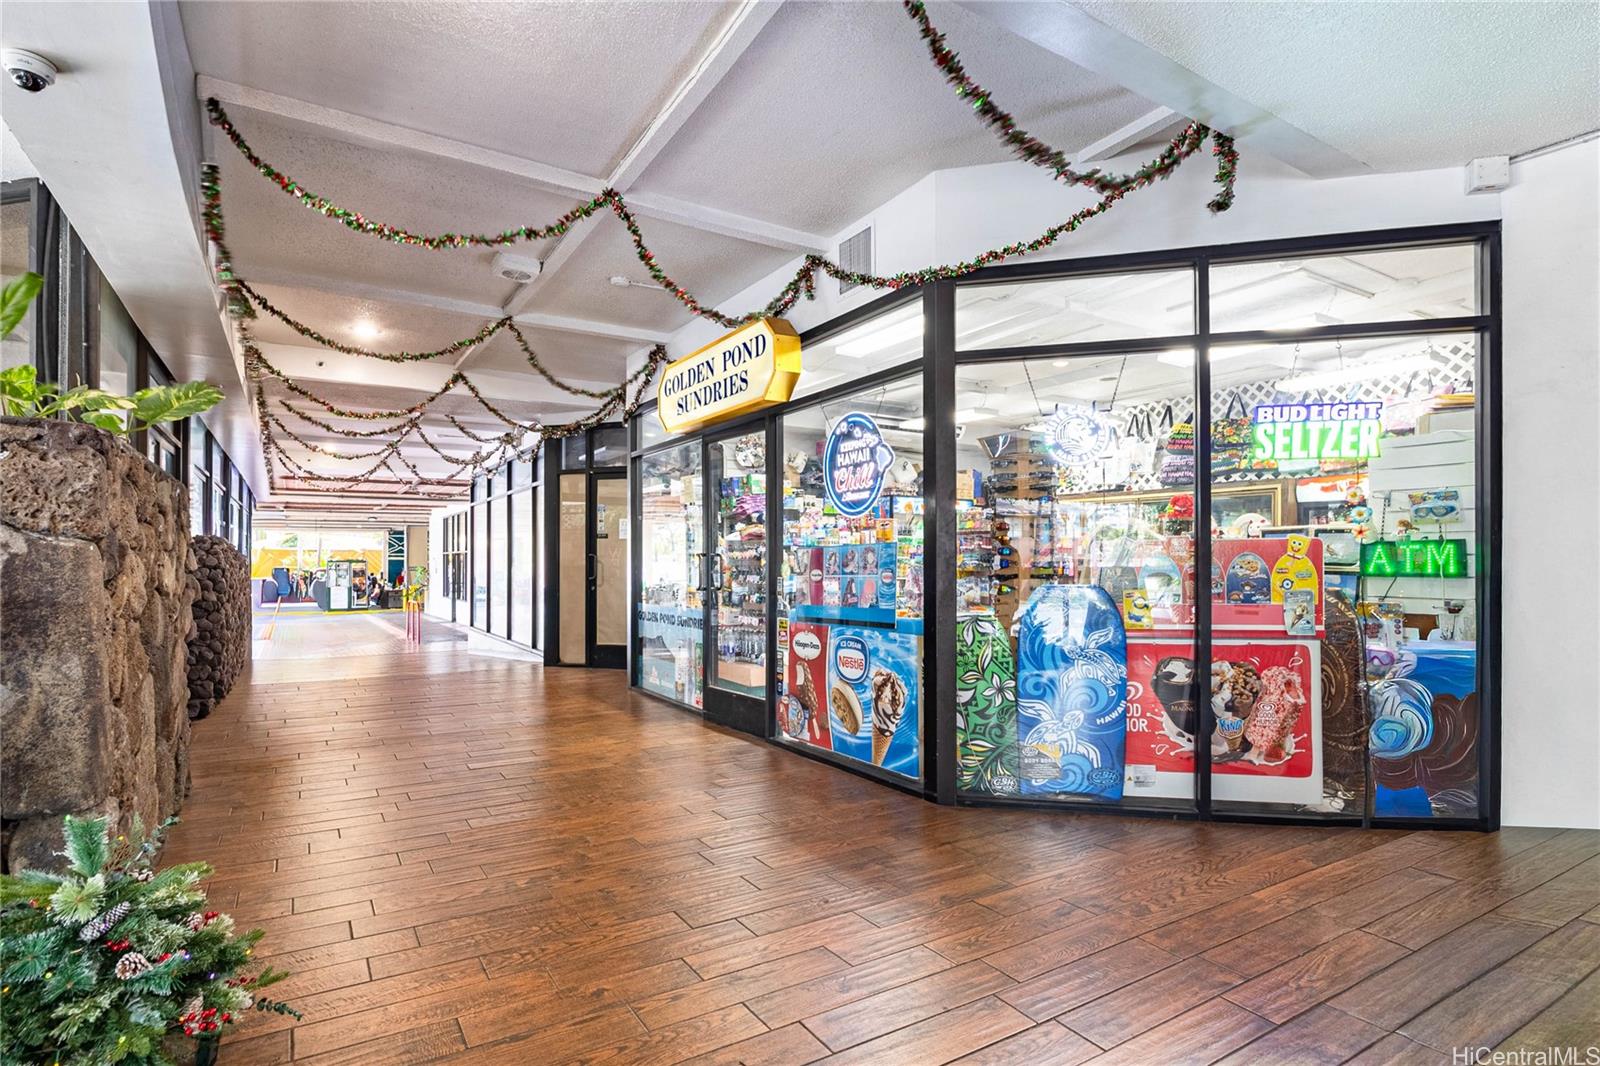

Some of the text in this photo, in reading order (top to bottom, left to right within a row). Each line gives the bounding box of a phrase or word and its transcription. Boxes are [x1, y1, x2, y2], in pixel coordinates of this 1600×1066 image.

[664, 334, 767, 397] GOLDEN POND
[677, 370, 749, 415] SUNDRIES
[1257, 403, 1381, 422] BUD LIGHT
[1255, 420, 1380, 459] SELTZER
[838, 447, 870, 467] HAWAII
[834, 461, 875, 492] Chill
[1368, 544, 1455, 573] ATM
[638, 610, 659, 623] GOLDEN
[660, 613, 676, 625] POND
